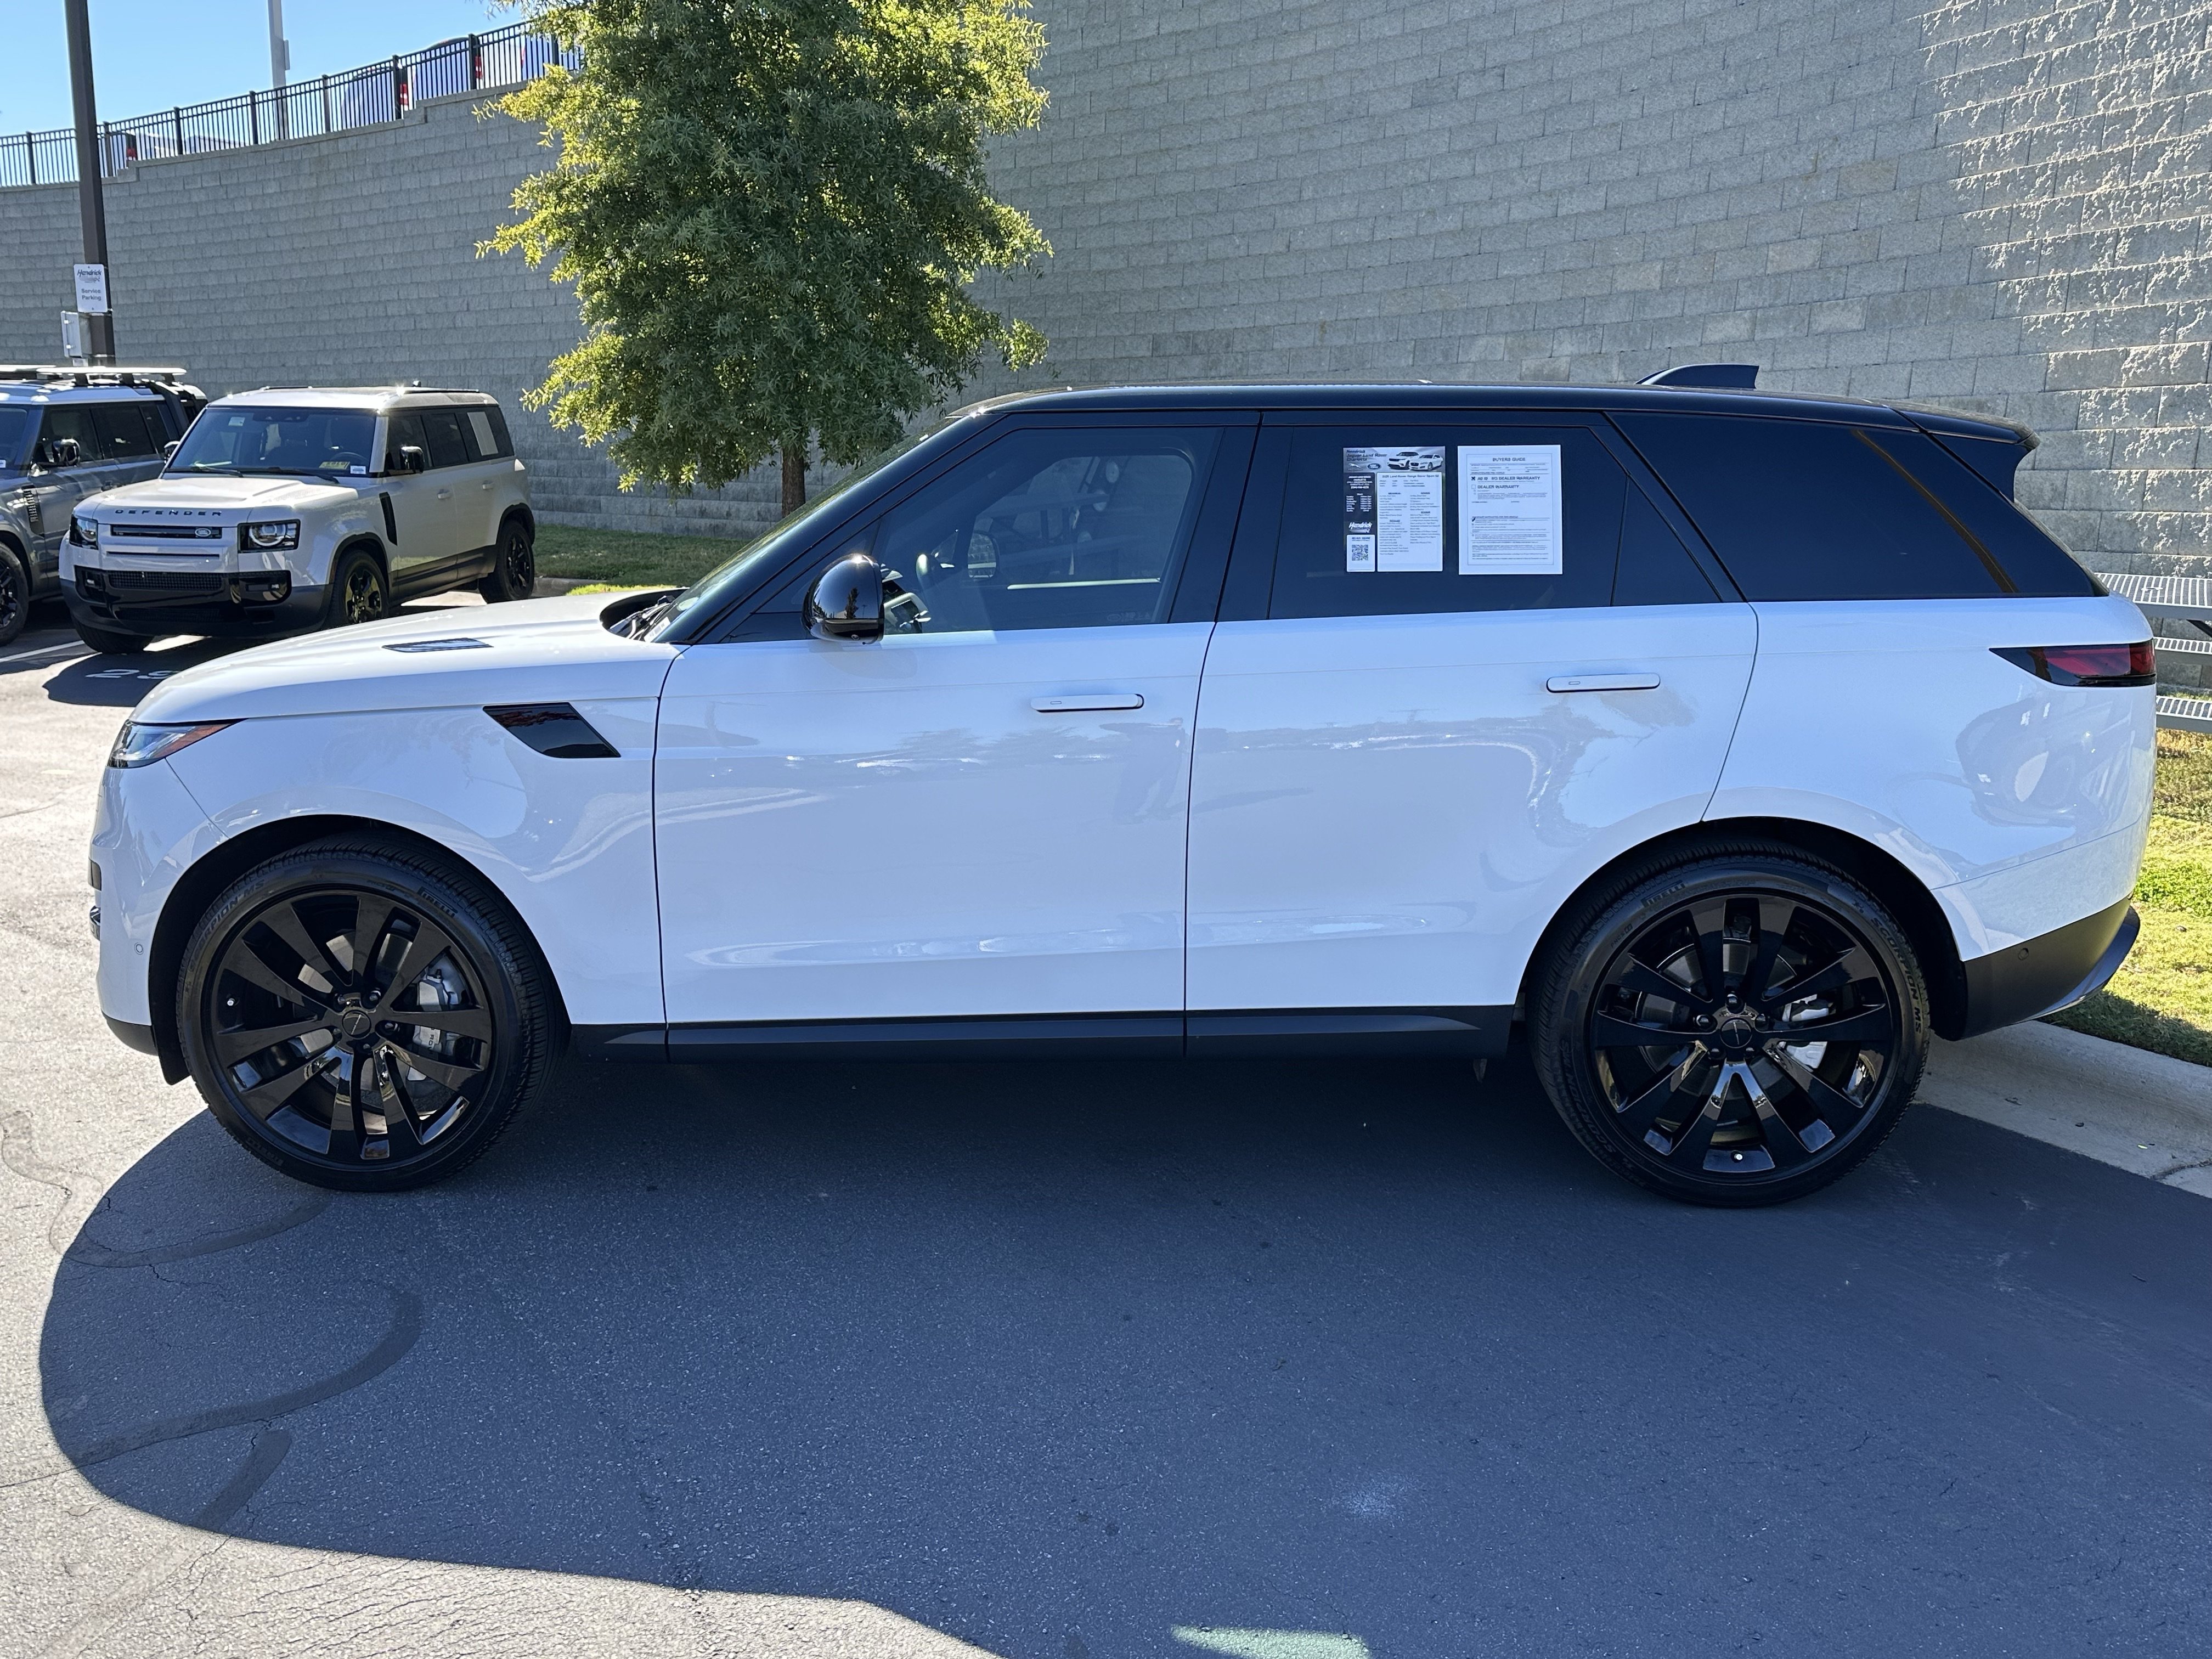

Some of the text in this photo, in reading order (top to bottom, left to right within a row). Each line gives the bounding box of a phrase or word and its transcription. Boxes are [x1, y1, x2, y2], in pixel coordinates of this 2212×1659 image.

[1640, 879, 1686, 908] PIRELLI
[1870, 917, 1923, 1035] SCORPION MS
